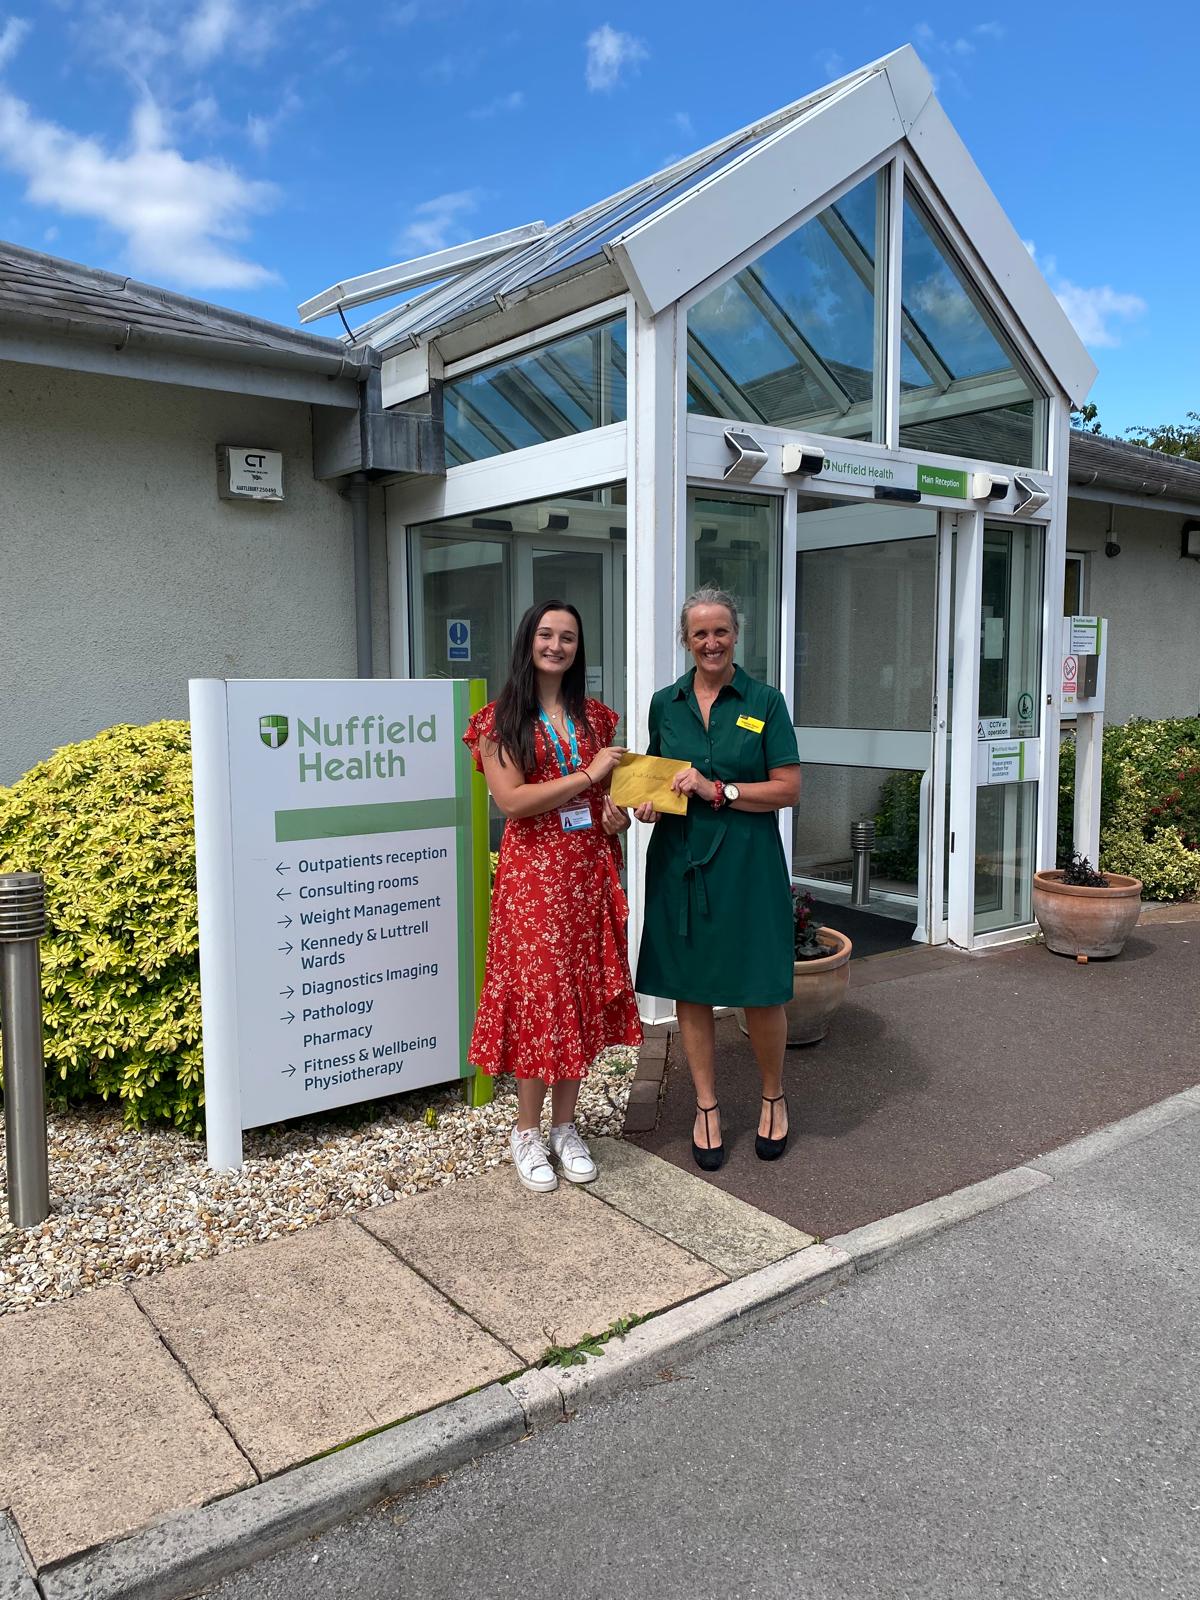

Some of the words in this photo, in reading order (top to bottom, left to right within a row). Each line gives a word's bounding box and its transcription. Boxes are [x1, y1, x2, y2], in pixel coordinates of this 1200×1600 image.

[244, 454, 266, 468] CT
[831, 461, 867, 476] Nuffield
[868, 467, 894, 480] Health
[921, 474, 934, 484] Main
[935, 476, 960, 488] Reception
[297, 714, 437, 748] Nuffield
[299, 749, 406, 783] Health
[298, 852, 383, 873] Outpatients
[386, 847, 447, 863] reception
[299, 880, 375, 899] Consulting
[378, 875, 419, 890] rooms
[300, 907, 351, 925] Weight
[354, 895, 441, 918] Management
[301, 931, 364, 951] Kennedy
[366, 928, 377, 941] &
[380, 920, 429, 939] Luttrell
[301, 951, 345, 970] Wards
[302, 971, 383, 996] Diagnostics
[386, 963, 438, 981] Imaging
[302, 999, 374, 1021] Pathology
[303, 1024, 373, 1048] Pharmacy
[304, 1053, 355, 1073] Fitness
[358, 1048, 369, 1062] &
[372, 1036, 437, 1058] Wellbeing
[304, 1060, 404, 1091] Physiotherapy
